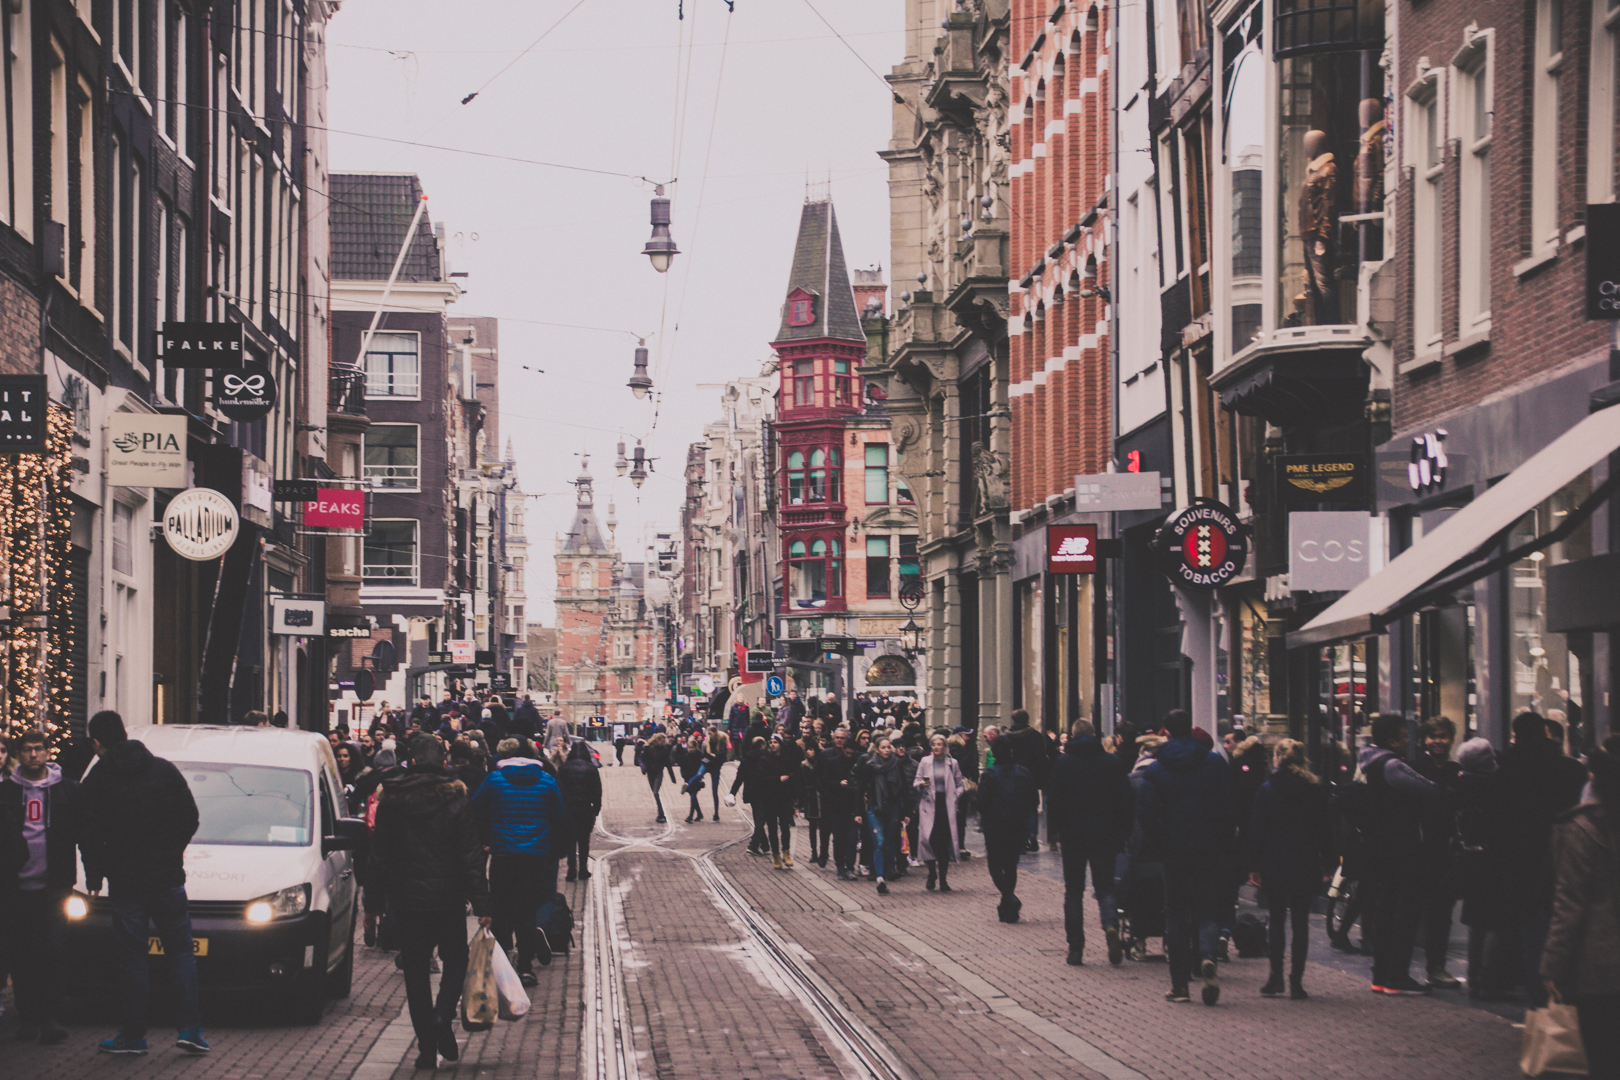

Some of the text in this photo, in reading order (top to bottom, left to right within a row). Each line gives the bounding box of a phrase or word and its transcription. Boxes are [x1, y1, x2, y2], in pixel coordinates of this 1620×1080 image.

[166, 340, 240, 351] FALKE
[142, 432, 181, 451] PIA
[1286, 462, 1355, 473] PME LEGEND
[307, 501, 361, 516] PEAKS
[168, 504, 233, 545] PALLADIUM
[1173, 508, 1237, 536] SOUVENIRS
[1298, 539, 1364, 563] COS
[1178, 560, 1236, 585] TOBACCO
[329, 626, 370, 637] sacha
